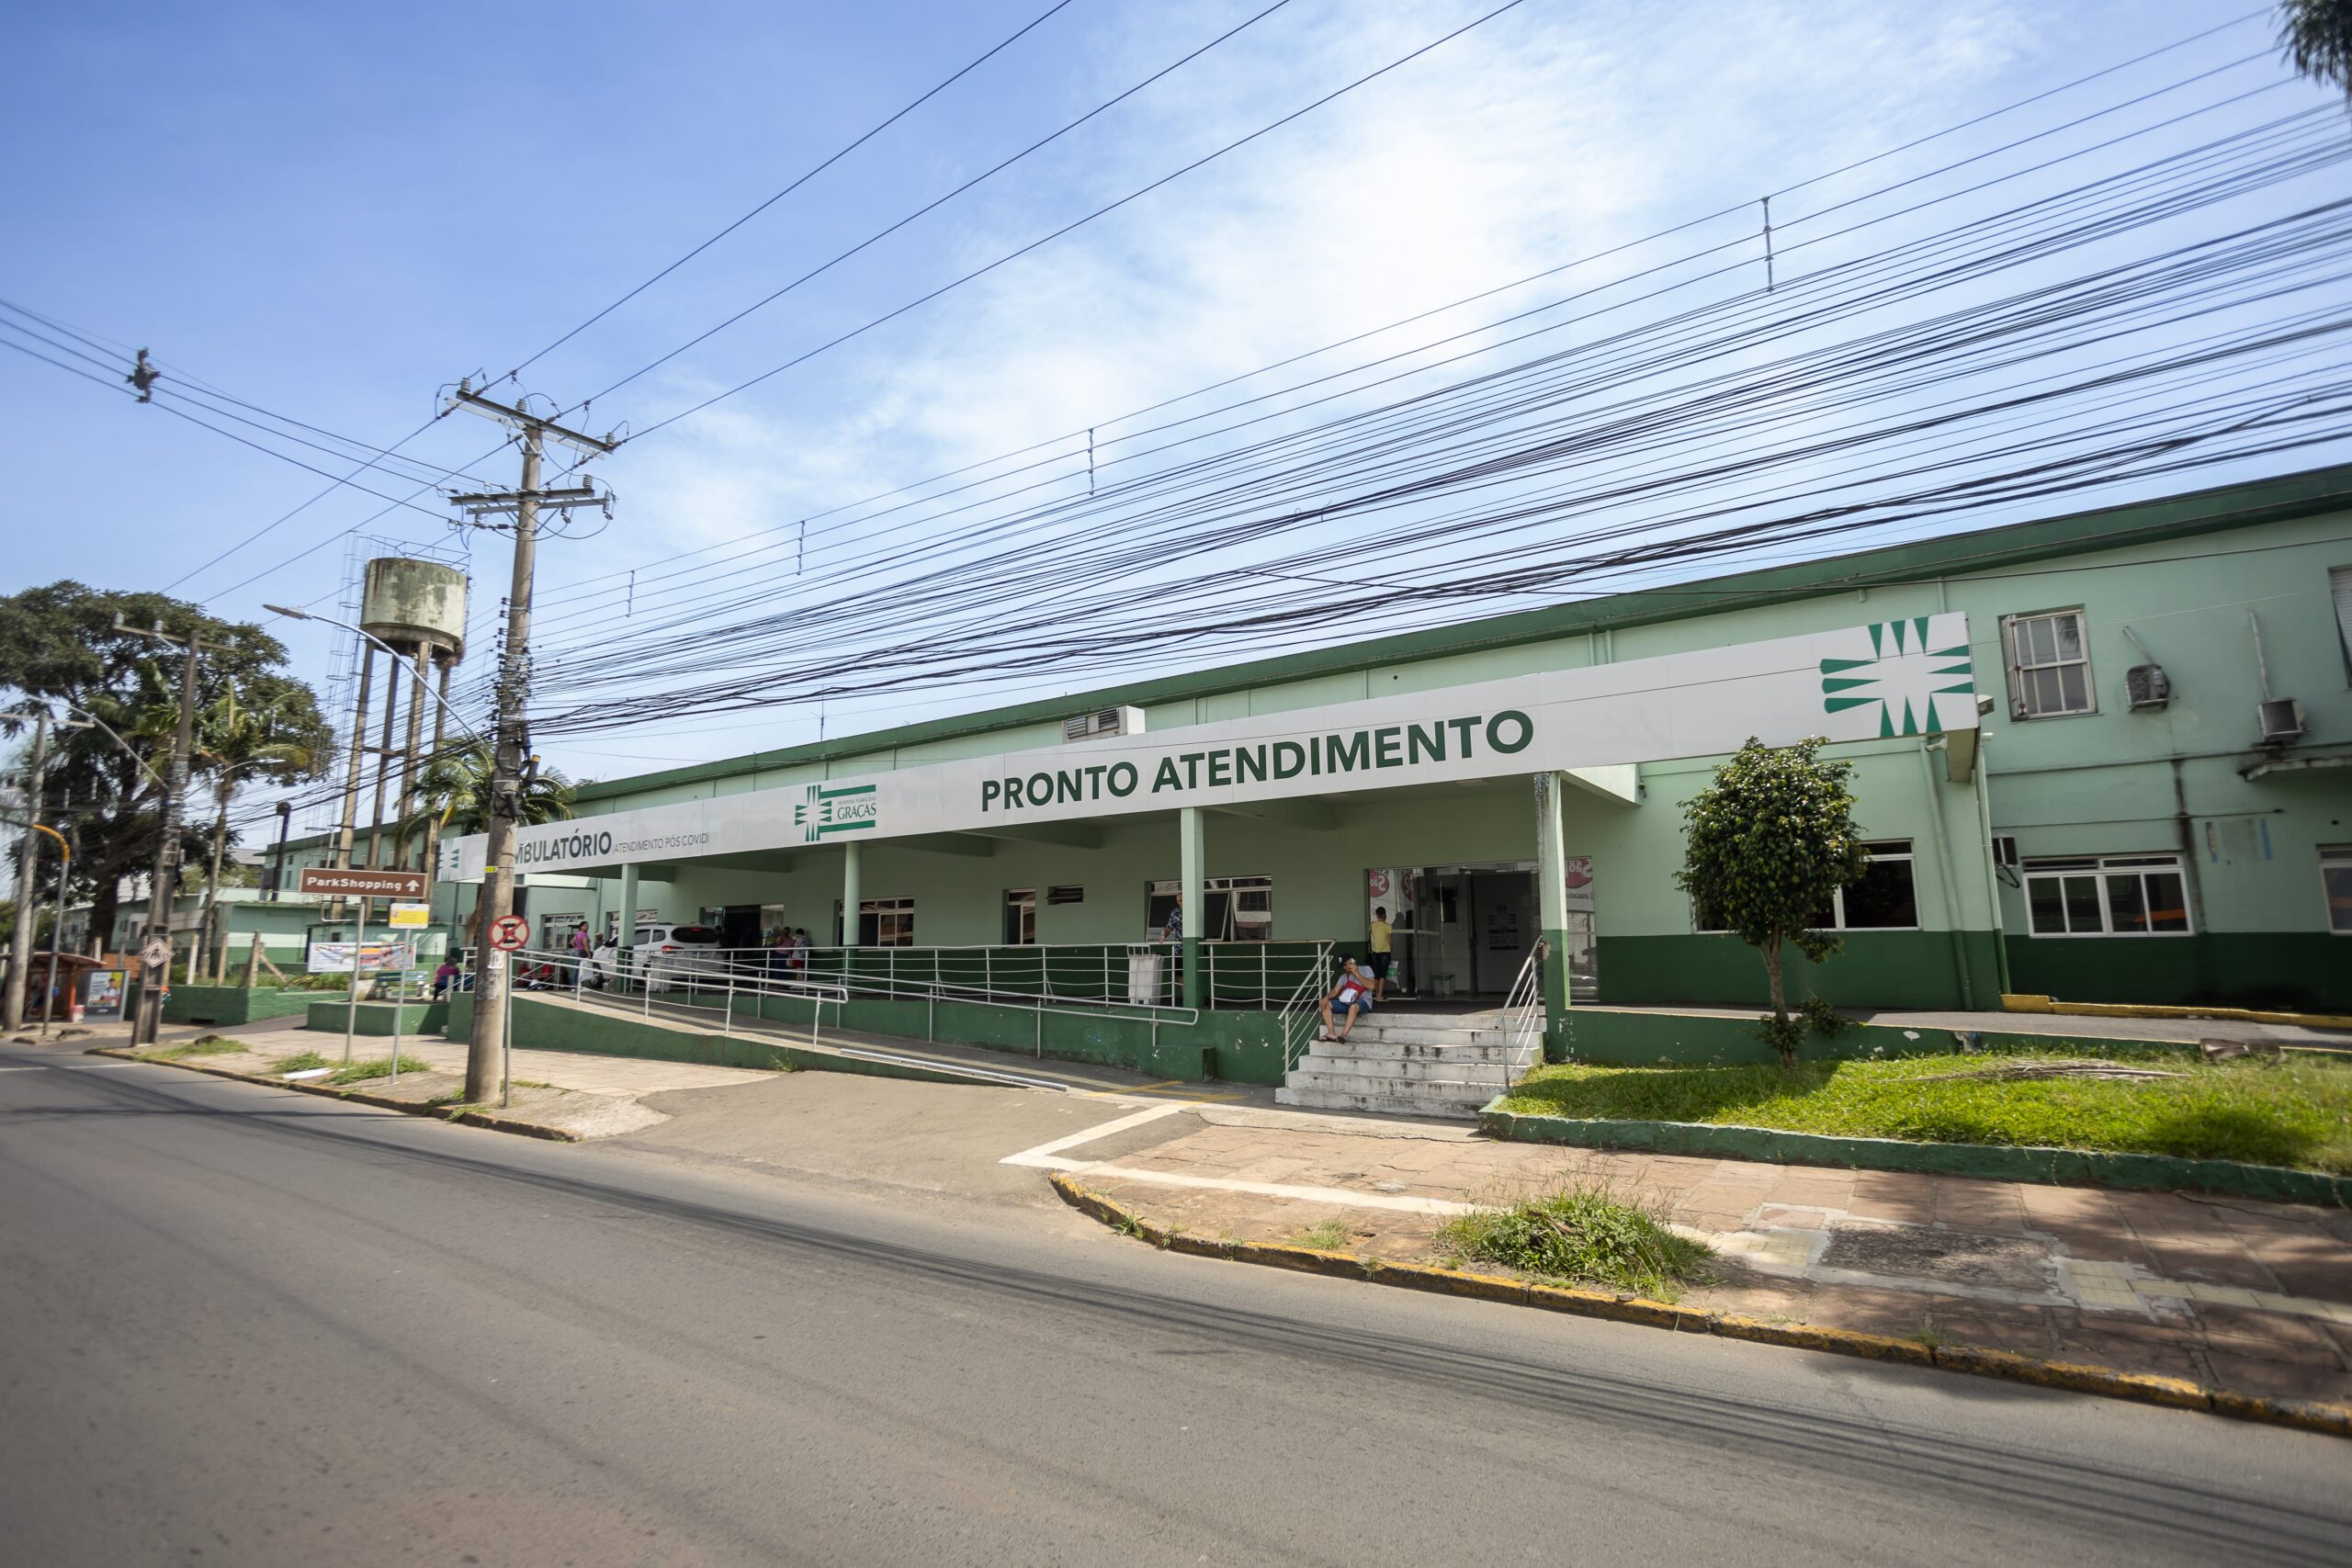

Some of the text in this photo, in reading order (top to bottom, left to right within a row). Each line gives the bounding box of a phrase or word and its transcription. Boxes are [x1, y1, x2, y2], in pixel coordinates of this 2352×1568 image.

[982, 709, 1534, 813] PRONTO ATENDIMENTO
[514, 828, 612, 864] MBULATÓRIO
[665, 833, 681, 848] PÓS
[682, 831, 709, 846] COVID)
[307, 876, 402, 892] ParkShopping
